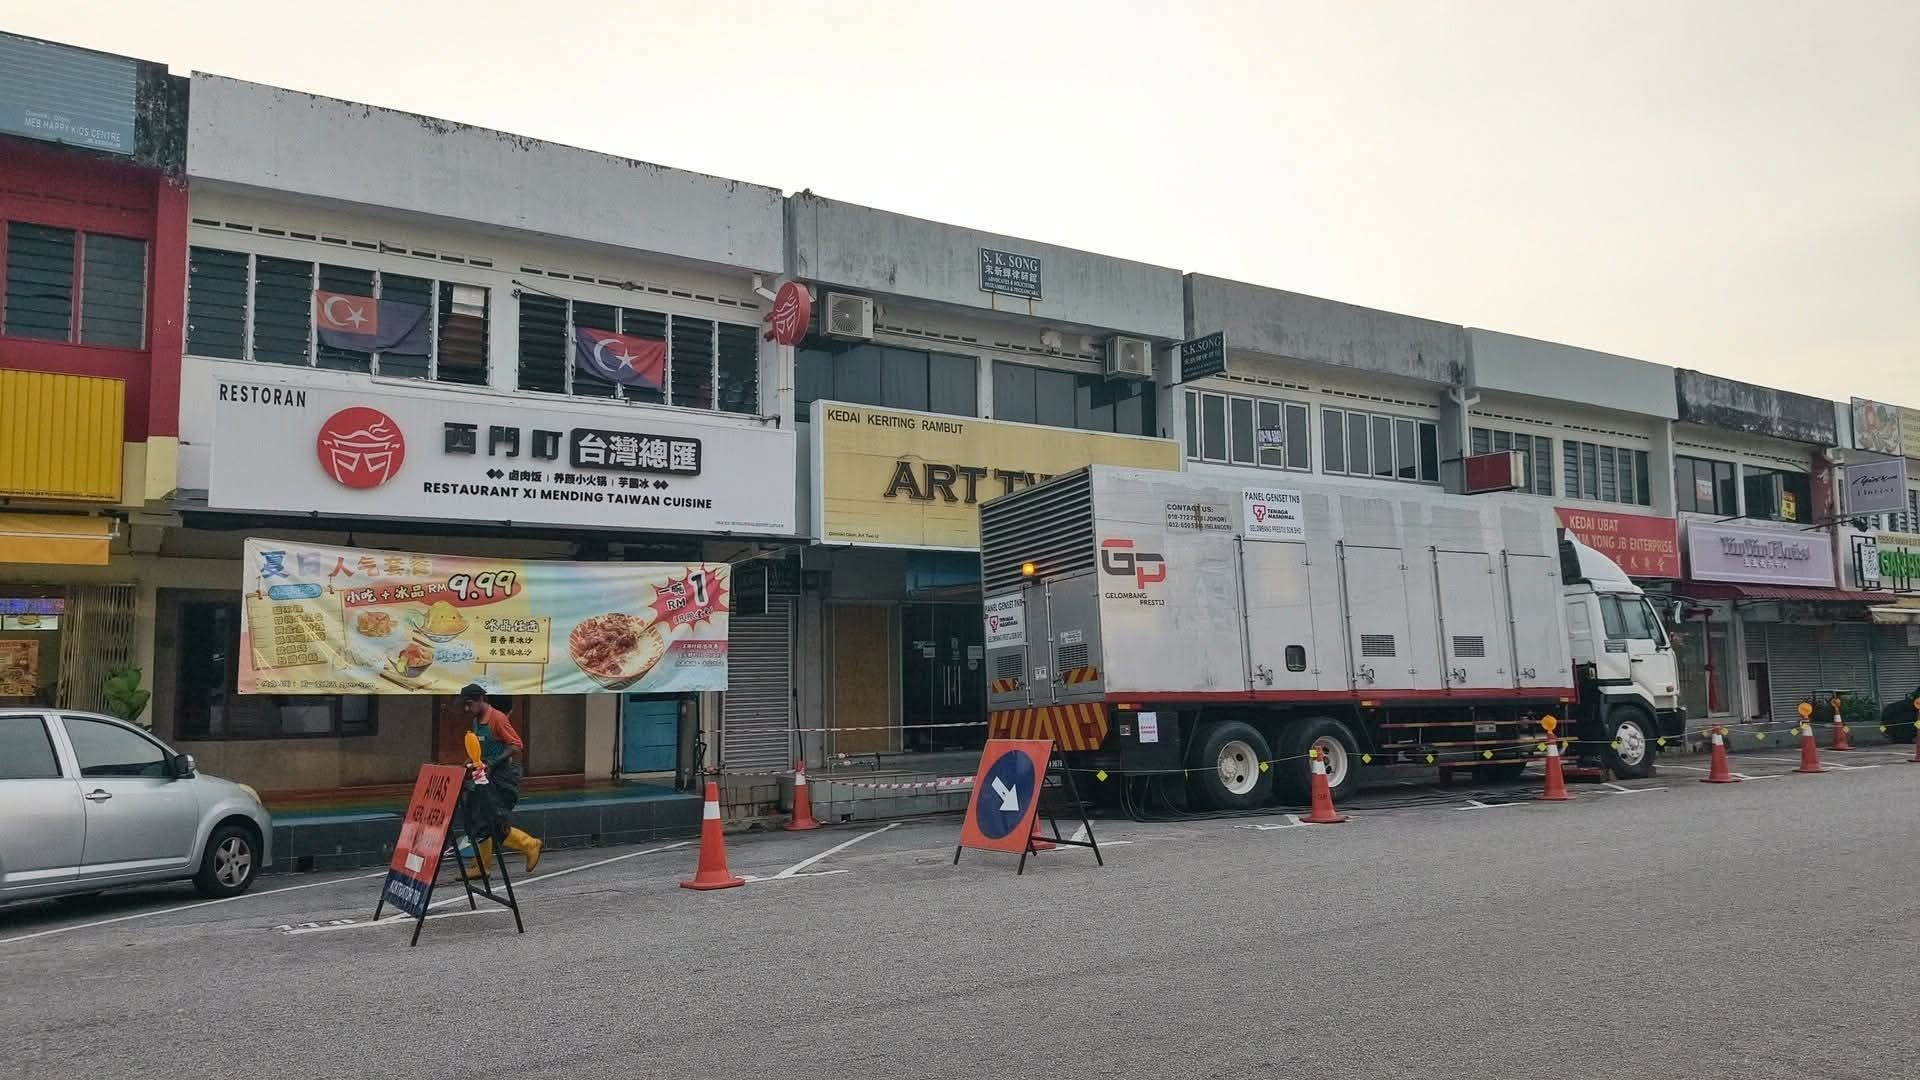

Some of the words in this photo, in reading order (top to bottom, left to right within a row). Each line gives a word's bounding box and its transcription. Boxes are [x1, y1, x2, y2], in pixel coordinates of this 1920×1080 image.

[1008, 255, 1039, 272] SONG
[219, 383, 307, 408] RESTORAN
[828, 409, 861, 424] KEDAI
[867, 413, 916, 430] KERITING
[921, 419, 964, 435] RAMBUT
[444, 422, 564, 461] 西門町
[577, 433, 698, 472] 台灣總匯
[884, 460, 988, 504] ART
[423, 481, 519, 499] RESTAURANT
[522, 487, 537, 500] XI
[540, 489, 604, 503] MENDING
[607, 493, 661, 507] TAIWAN
[663, 496, 713, 510] CUISINE
[1244, 491, 1265, 502] PANEL
[1265, 493, 1289, 504] GENSET
[1288, 494, 1301, 505] TNB
[1202, 506, 1214, 514] US:
[1569, 515, 1595, 529] KEDAI
[1598, 518, 1618, 532] UBAT
[1591, 534, 1616, 549] YONG
[1617, 537, 1627, 550] JB
[1630, 537, 1674, 553] ENTERPRISE
[261, 551, 433, 580] 夏日人气套餐
[1101, 538, 1166, 590] GP
[346, 588, 377, 604] 小吃
[395, 584, 424, 600] 冰品
[428, 584, 448, 594] RM
[449, 570, 517, 600] 9.99
[667, 598, 687, 611] RM
[689, 571, 708, 606] 1
[1139, 599, 1166, 607] PRESTIJ
[424, 774, 451, 802] AWAS
